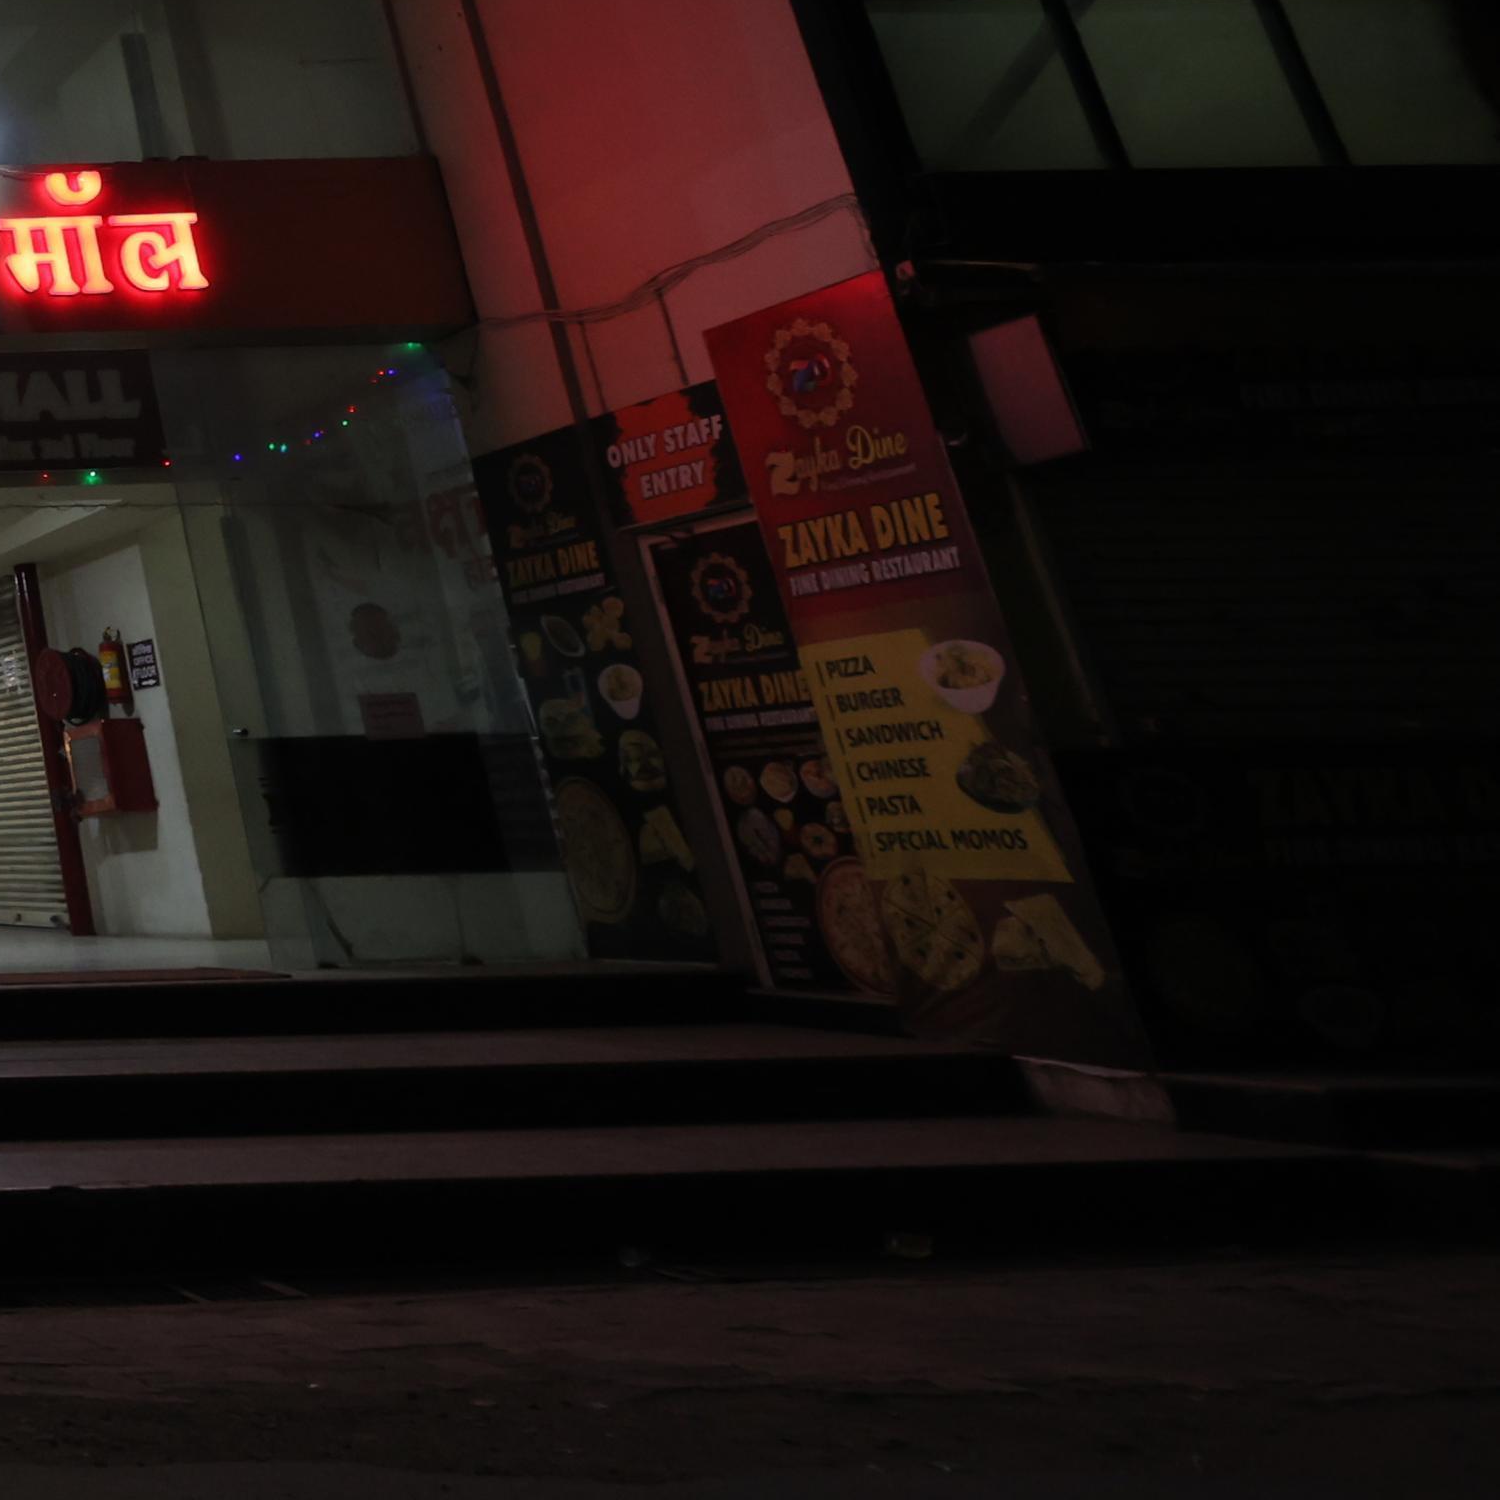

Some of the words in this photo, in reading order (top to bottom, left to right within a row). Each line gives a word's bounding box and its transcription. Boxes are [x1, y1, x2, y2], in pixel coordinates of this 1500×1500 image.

[607, 434, 656, 468] ONLY
[664, 414, 723, 453] STAFF
[847, 425, 907, 470] Dine
[640, 460, 705, 499] ENTRY
[777, 510, 870, 569] ZAYKA
[870, 493, 950, 550] DINE
[789, 572, 818, 597] FINE
[820, 563, 870, 590] DINING
[872, 546, 960, 580] RESTAURANT
[825, 655, 876, 679] PIZZA
[698, 676, 760, 712] ZAYKA
[759, 669, 812, 704] DINE
[836, 687, 904, 713] BURGER
[845, 721, 944, 747] SANDWICH
[856, 758, 931, 782] CHINESE
[866, 795, 922, 816] PASTA
[874, 829, 949, 852] SPECIAL
[951, 828, 1028, 851] MOMOS
